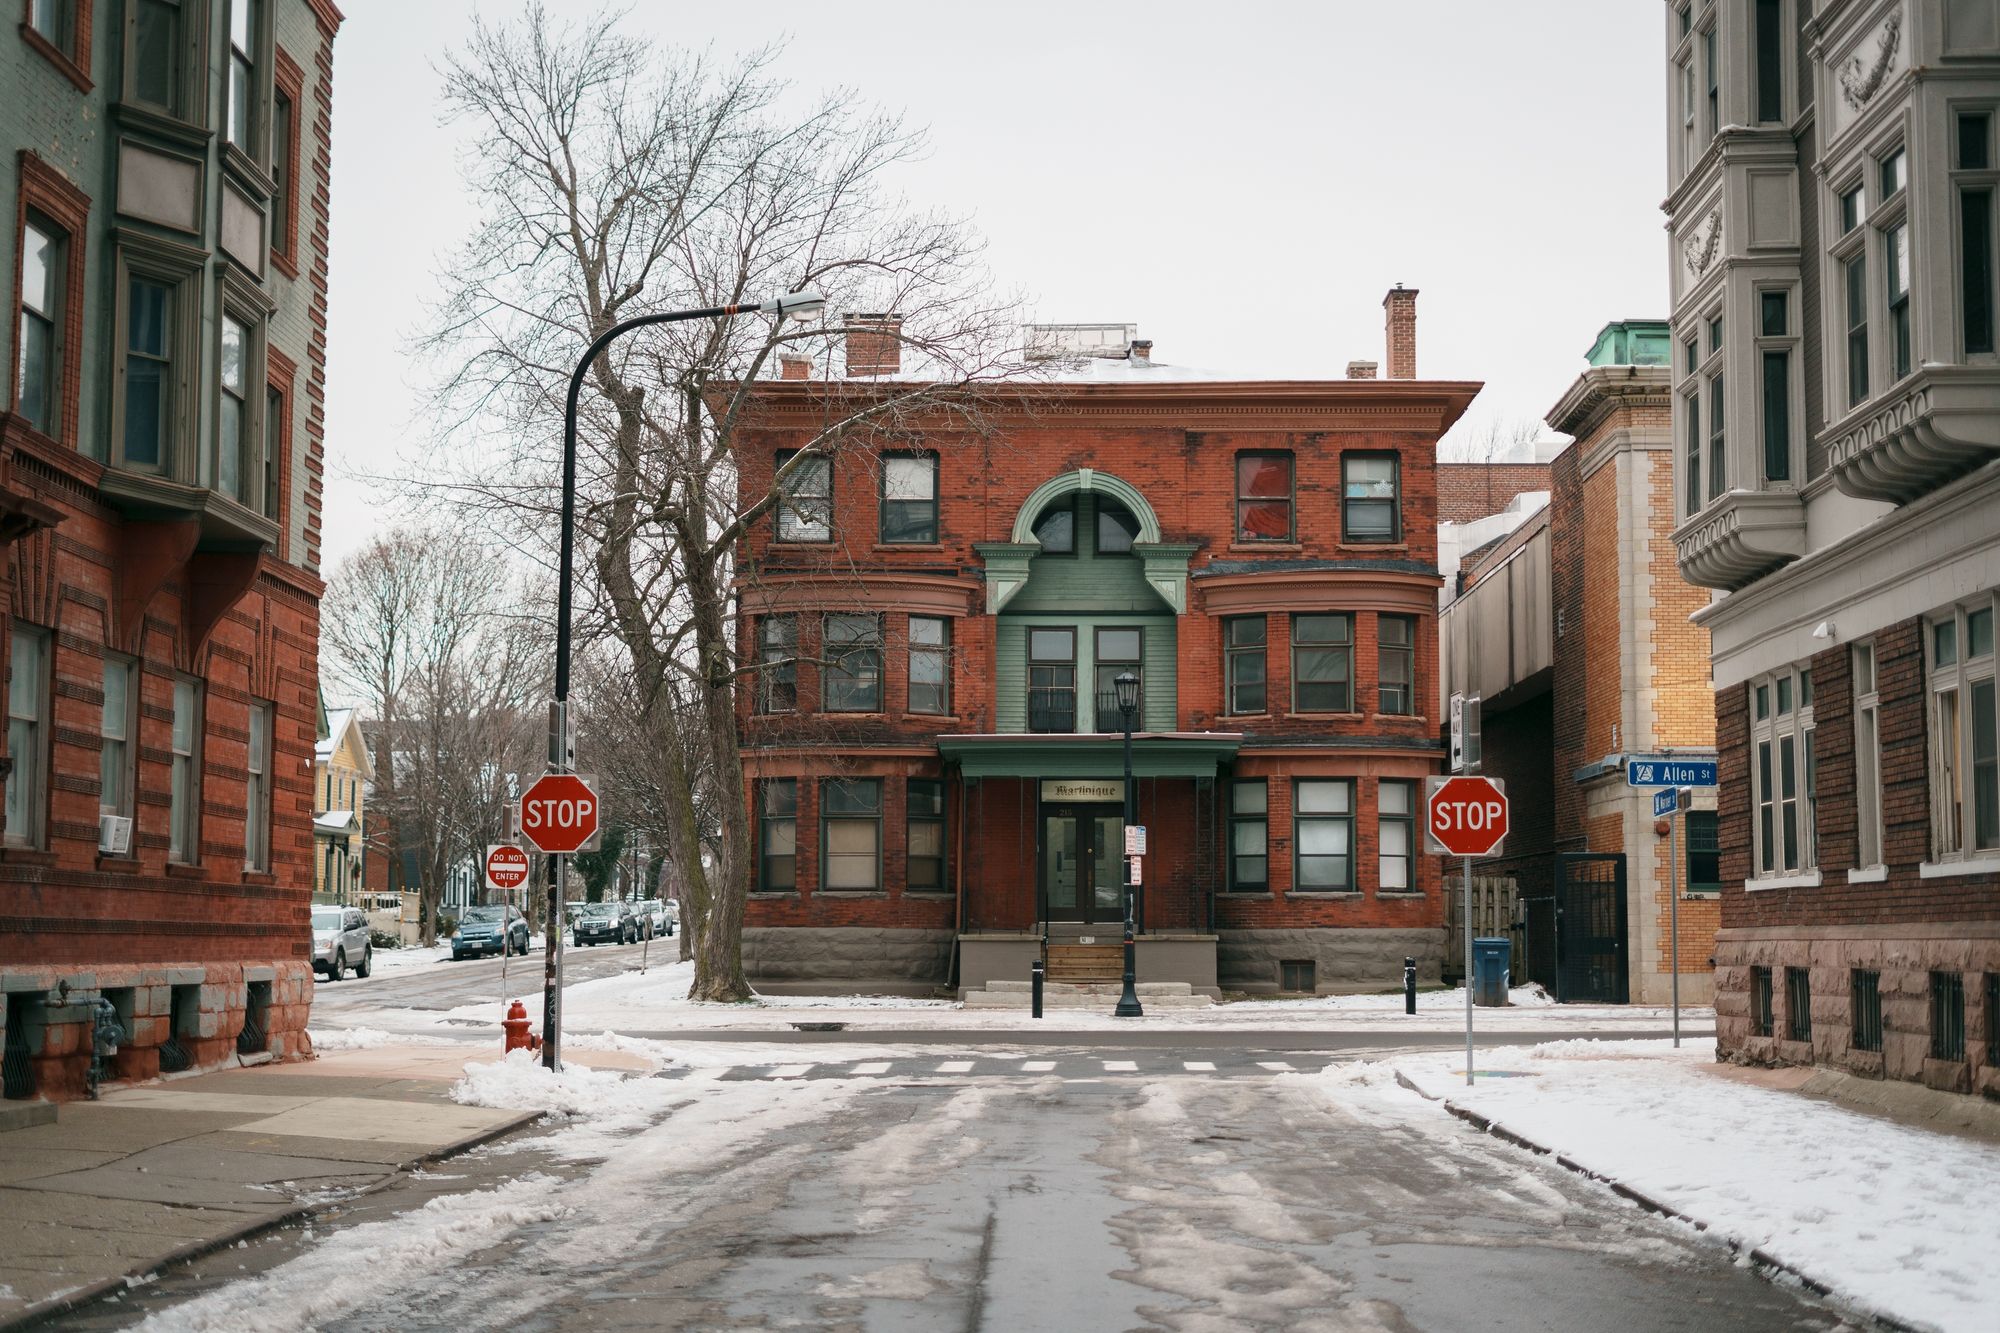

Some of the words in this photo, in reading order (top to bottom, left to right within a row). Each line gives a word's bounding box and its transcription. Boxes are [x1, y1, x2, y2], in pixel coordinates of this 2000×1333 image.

[1663, 766, 1695, 781] Allen
[1701, 769, 1710, 779] St
[1054, 785, 1116, 797] Martinique
[526, 799, 592, 828] STOP
[1435, 801, 1502, 830] STOP
[508, 854, 523, 862] NOT
[495, 872, 519, 880] ENTER
